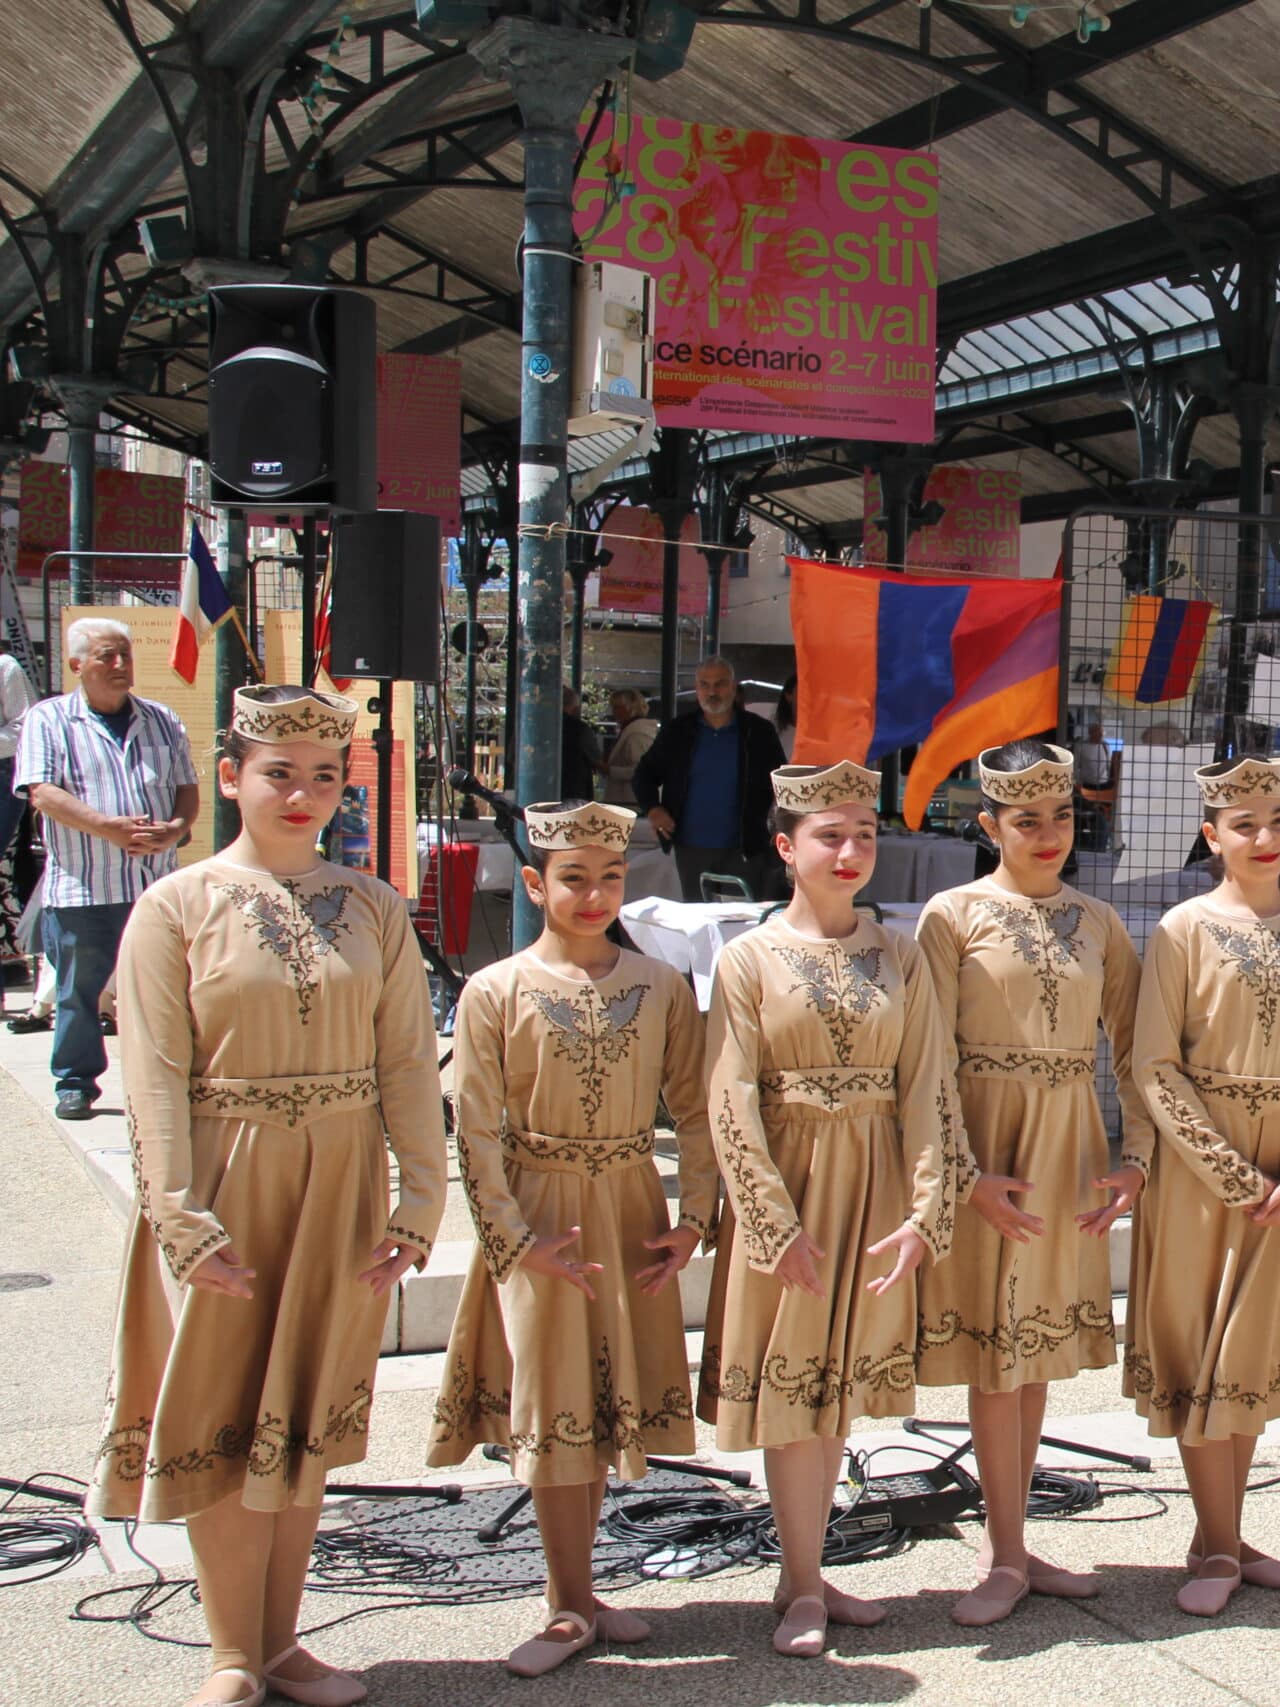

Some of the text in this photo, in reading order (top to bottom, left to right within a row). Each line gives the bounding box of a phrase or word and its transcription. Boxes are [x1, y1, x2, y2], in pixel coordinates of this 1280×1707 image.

[708, 274, 929, 347] Festival
[699, 340, 823, 374] scénario
[883, 353, 931, 385] juin
[920, 525, 1019, 559] Festival
